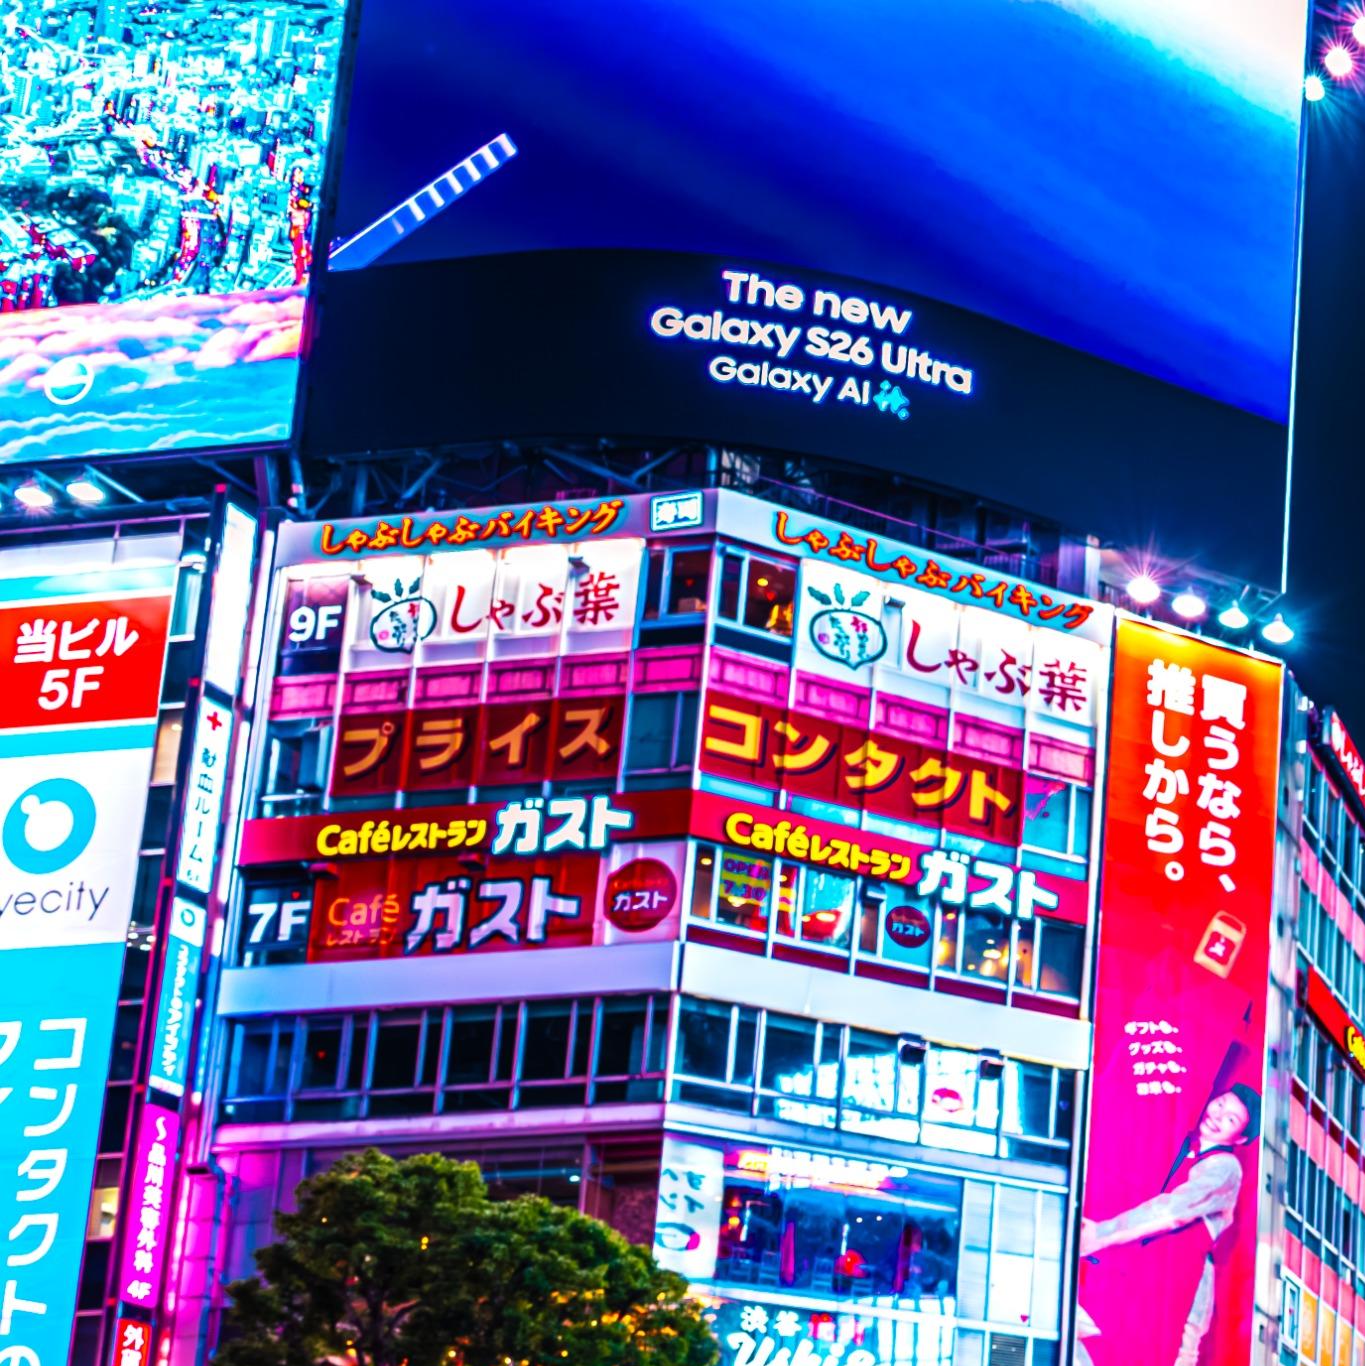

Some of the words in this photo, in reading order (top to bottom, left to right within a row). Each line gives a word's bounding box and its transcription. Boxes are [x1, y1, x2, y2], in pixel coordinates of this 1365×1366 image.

[722, 270, 804, 311] The
[812, 289, 912, 334] new
[650, 306, 801, 357] Galaxy
[805, 326, 874, 367] S26
[880, 341, 974, 394] Ultra
[708, 355, 833, 403] Galaxy
[837, 376, 870, 405] AI
[320, 501, 624, 554] しゃぶしゃぶバイキング
[774, 511, 1094, 631] しゃぶしゃぶバイキング
[288, 605, 341, 641] 9F
[450, 572, 621, 635] しゃぶ葉
[14, 617, 138, 664] 当ビル
[906, 618, 1088, 713] しゃぶ葉
[38, 666, 105, 710] 5F
[341, 706, 611, 779] プライス
[704, 704, 1011, 823] コンタクト
[1143, 659, 1196, 882] 推しから。
[1196, 671, 1248, 893] 買うなら、
[316, 817, 487, 858] Caféレストラン
[493, 796, 633, 857] ガスト
[725, 811, 912, 880] Caféレストラン
[917, 850, 1059, 920] ガスト
[248, 900, 310, 945] 7F
[327, 894, 400, 928] Café
[404, 876, 582, 954] ガスト
[613, 889, 668, 912] ガスト
